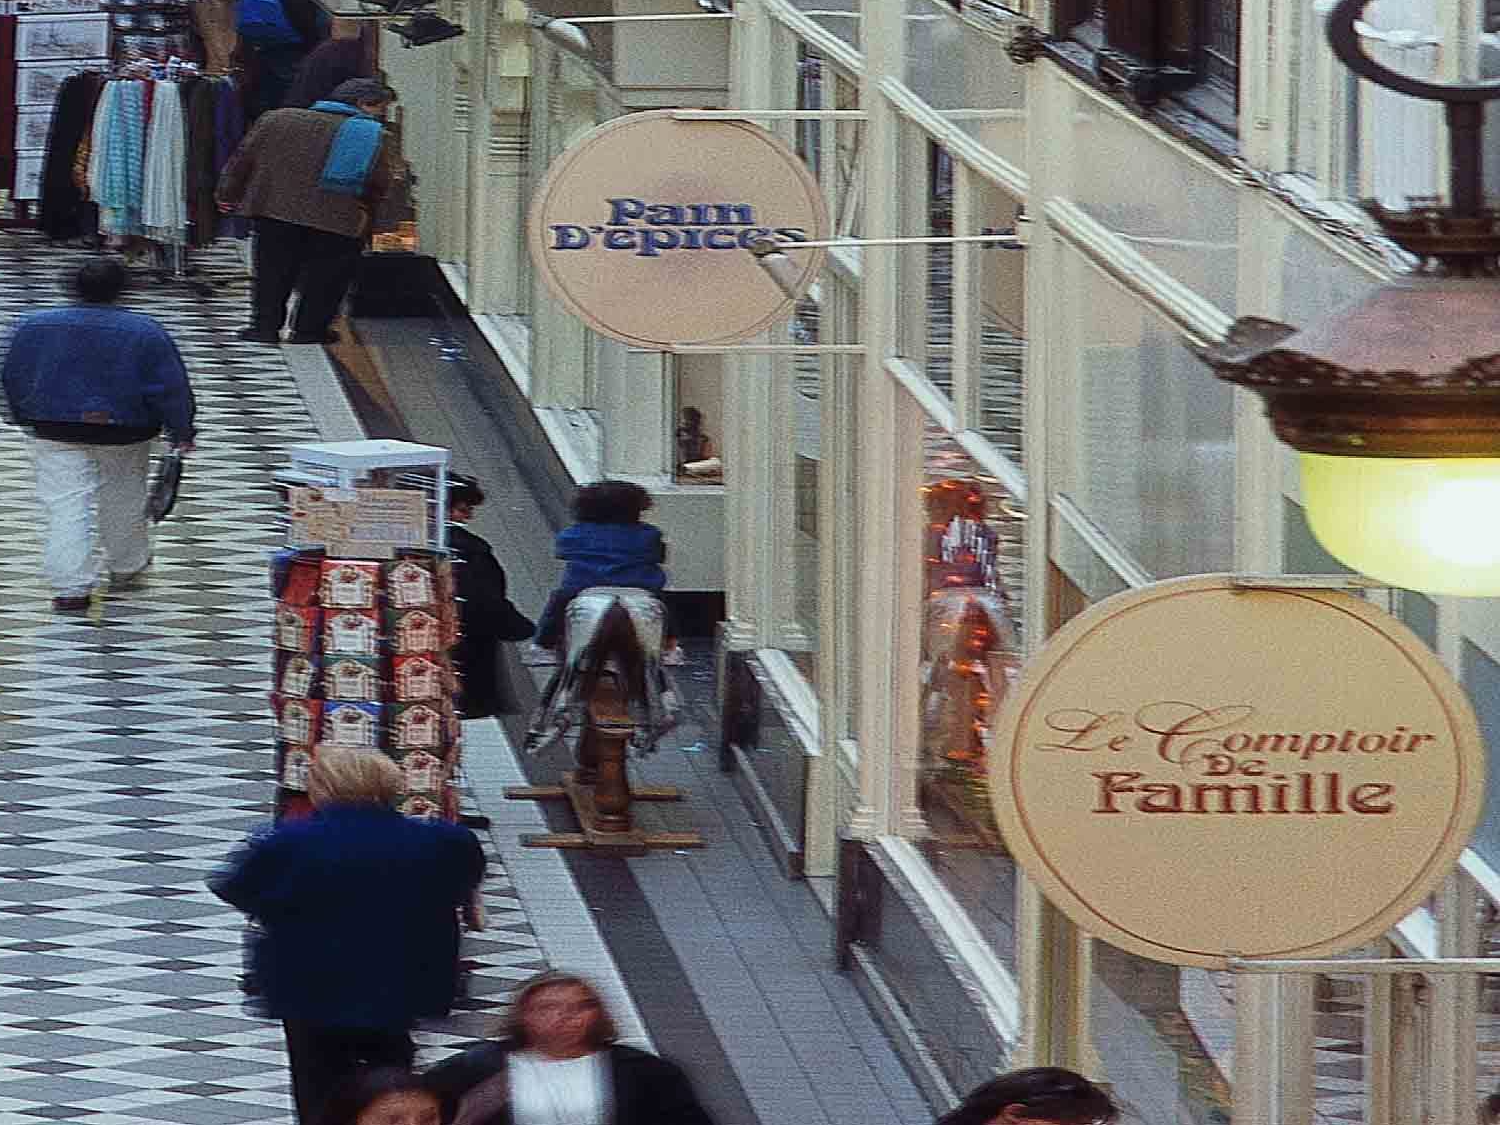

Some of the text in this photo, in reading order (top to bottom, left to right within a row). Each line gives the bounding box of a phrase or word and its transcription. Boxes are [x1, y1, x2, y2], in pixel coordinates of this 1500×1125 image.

[607, 198, 757, 226] Pain
[1034, 700, 1437, 769] Le Comptoir
[1091, 771, 1397, 815] Famille
